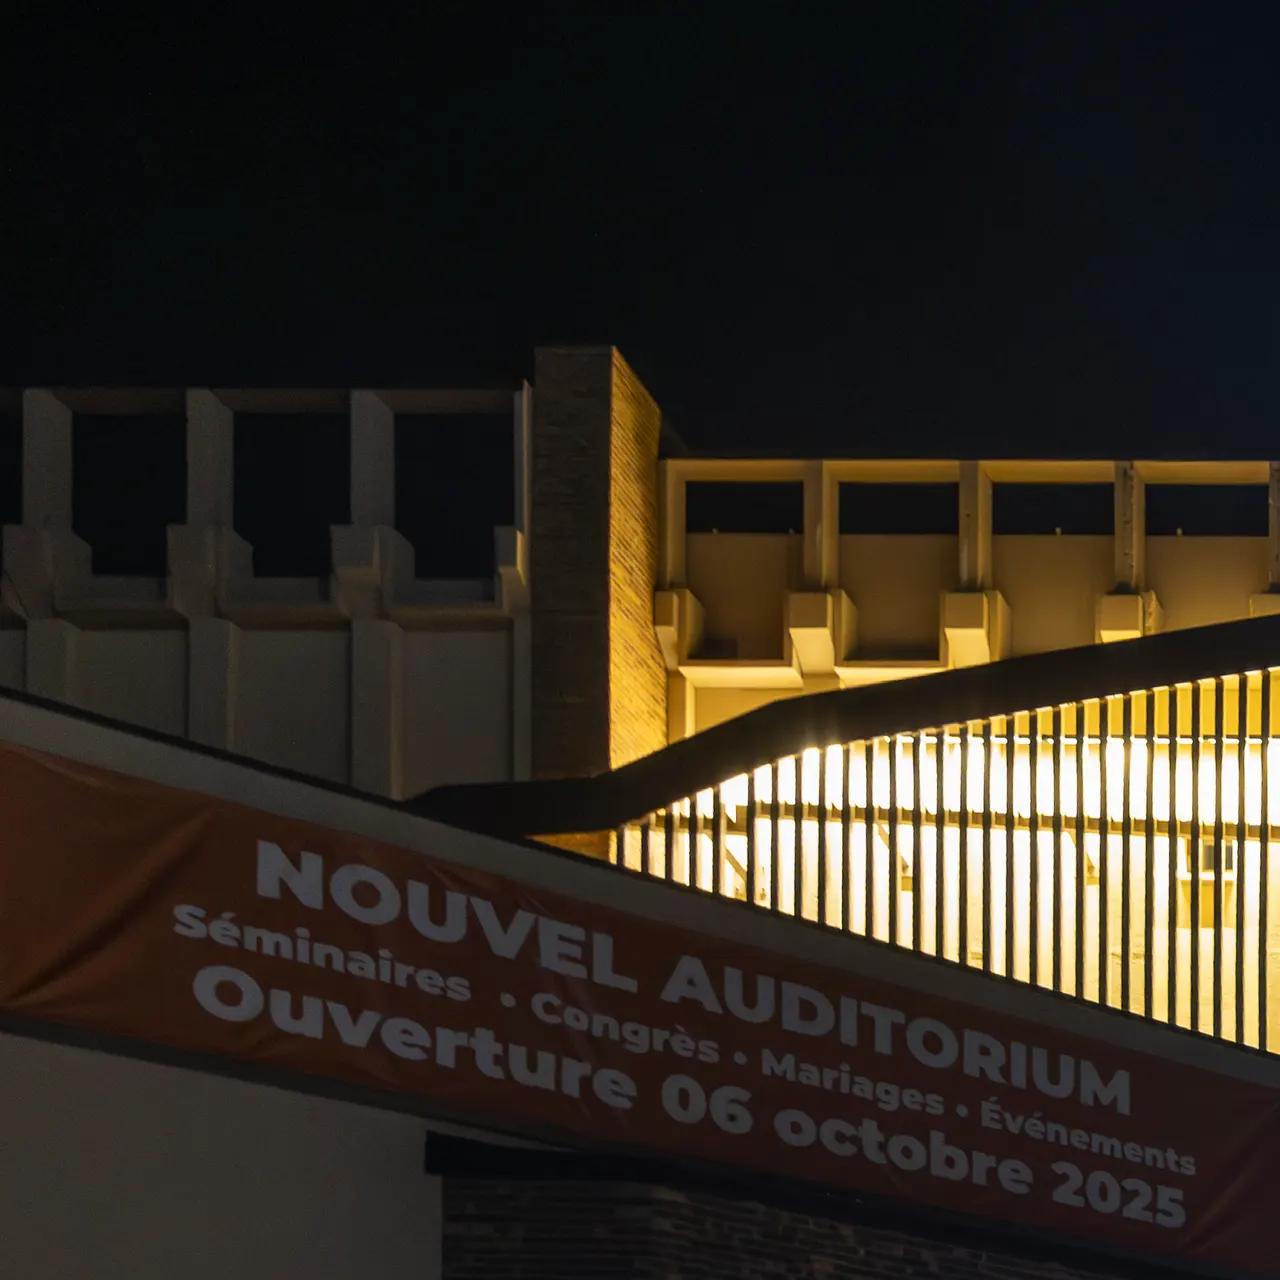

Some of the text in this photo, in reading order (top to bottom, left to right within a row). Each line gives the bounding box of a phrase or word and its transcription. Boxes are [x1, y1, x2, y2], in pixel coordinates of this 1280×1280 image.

[172, 902, 1197, 1177] Séminaires Congrès Mariages Événements
[191, 964, 1187, 1229] Ouverture 06 octobre 2025
[256, 839, 1132, 1116] NOUVEL AUDITORIUM
